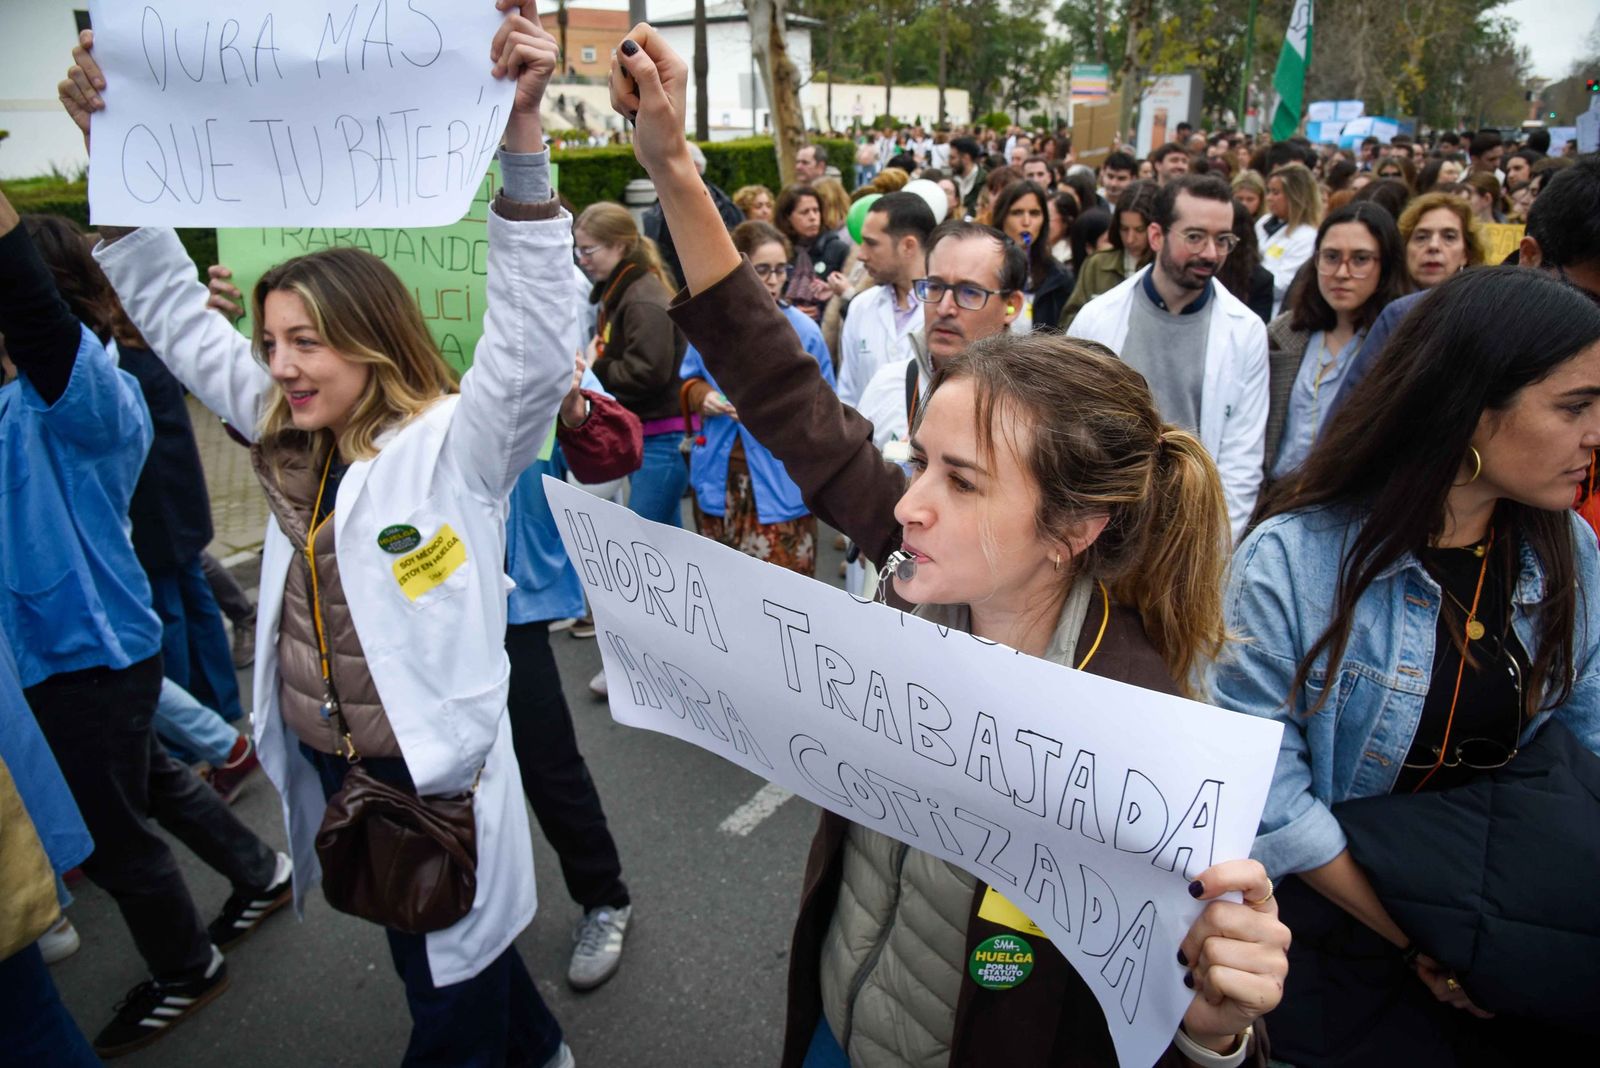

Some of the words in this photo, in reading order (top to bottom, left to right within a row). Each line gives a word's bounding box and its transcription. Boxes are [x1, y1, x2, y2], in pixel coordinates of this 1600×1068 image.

[121, 118, 242, 206] QUE
[248, 119, 324, 210] TU
[334, 85, 500, 212] BATERÍA
[399, 556, 417, 570] SOY
[420, 560, 434, 571] EN
[432, 536, 460, 565] HUELGA
[564, 508, 728, 653] HORA
[763, 599, 1225, 882] TRABAJADA
[605, 630, 775, 770] HORA
[975, 951, 1033, 963] HUELGA
[985, 963, 1004, 971] POR
[978, 968, 1024, 977] ESTATUTO
